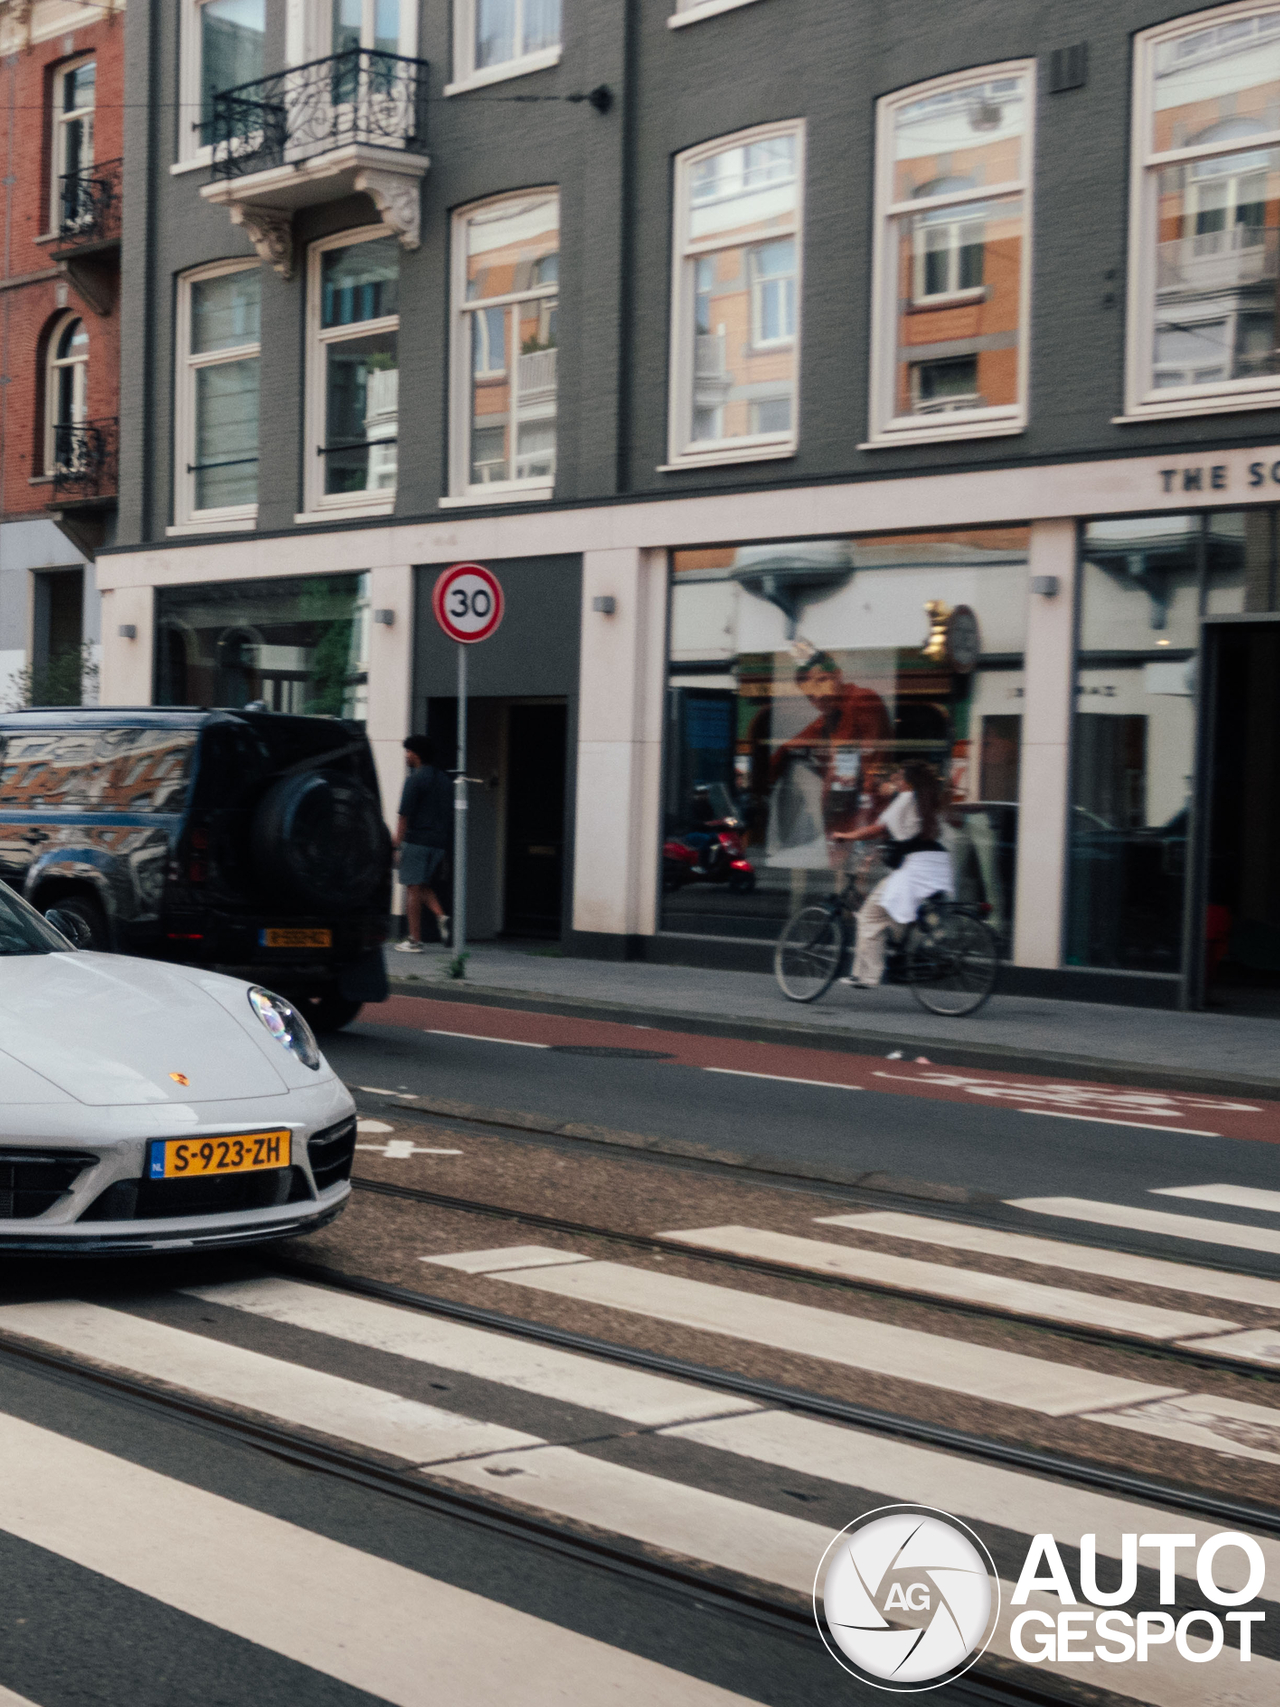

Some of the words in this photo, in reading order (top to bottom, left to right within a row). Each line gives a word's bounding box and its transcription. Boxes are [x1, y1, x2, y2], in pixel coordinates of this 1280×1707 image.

[1159, 465, 1226, 492] THE
[450, 589, 491, 617] 30
[174, 1136, 280, 1171] S-923-ZH
